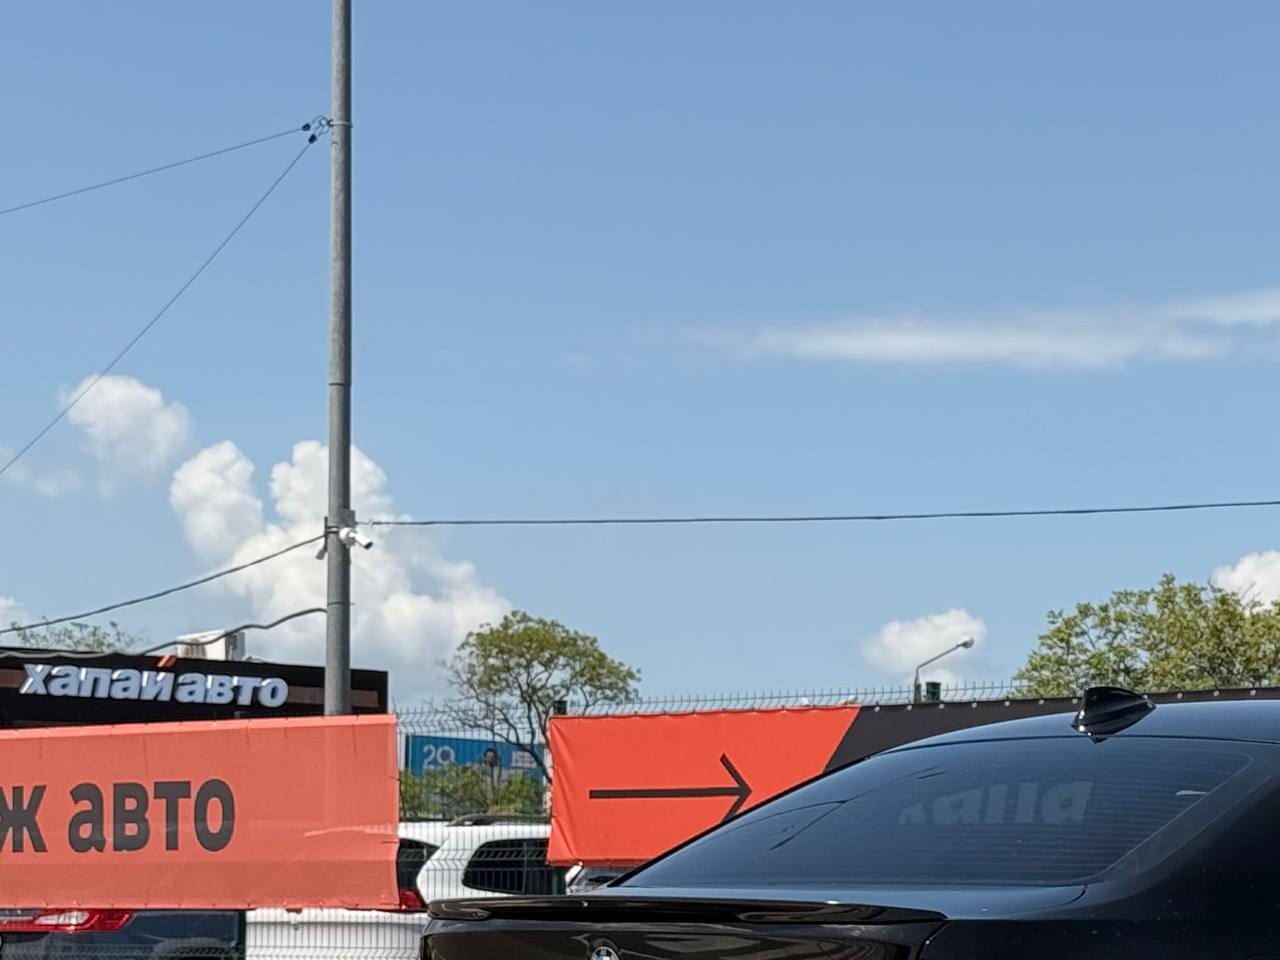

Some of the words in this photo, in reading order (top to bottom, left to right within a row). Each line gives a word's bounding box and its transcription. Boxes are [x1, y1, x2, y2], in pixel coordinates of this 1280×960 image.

[18, 654, 178, 702] хапай
[174, 671, 290, 709] авто
[67, 778, 236, 854] авто
